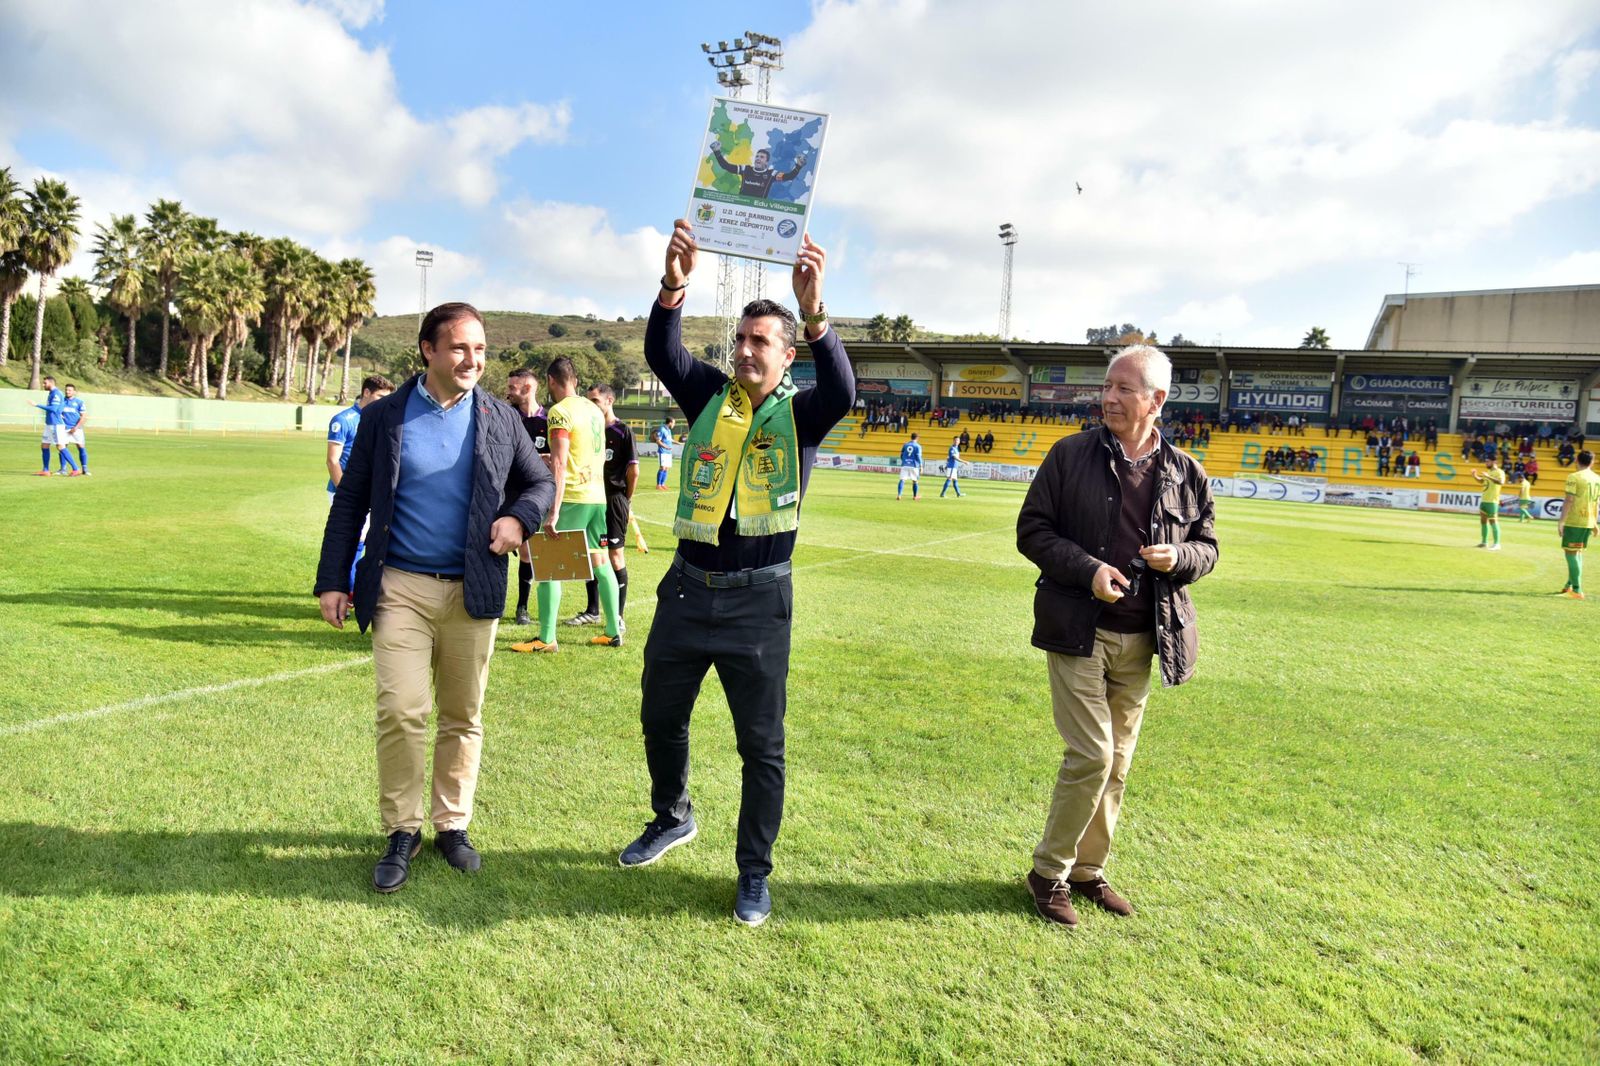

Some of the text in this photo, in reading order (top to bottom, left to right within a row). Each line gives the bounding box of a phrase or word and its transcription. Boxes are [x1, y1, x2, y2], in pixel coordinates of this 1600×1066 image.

[753, 200, 798, 213] Edu Villegas
[735, 210, 747, 218] LOS
[748, 212, 775, 222] BARRIOS
[719, 218, 739, 226] XEREZ
[739, 221, 774, 232] DEPORTIVO
[1369, 379, 1446, 389] GUADACORTE
[961, 385, 1018, 396] SOTOVILA
[1237, 392, 1324, 408] HYUNDAI
[1354, 400, 1448, 409] CADIMAR CADIMAR
[906, 445, 914, 457] 9
